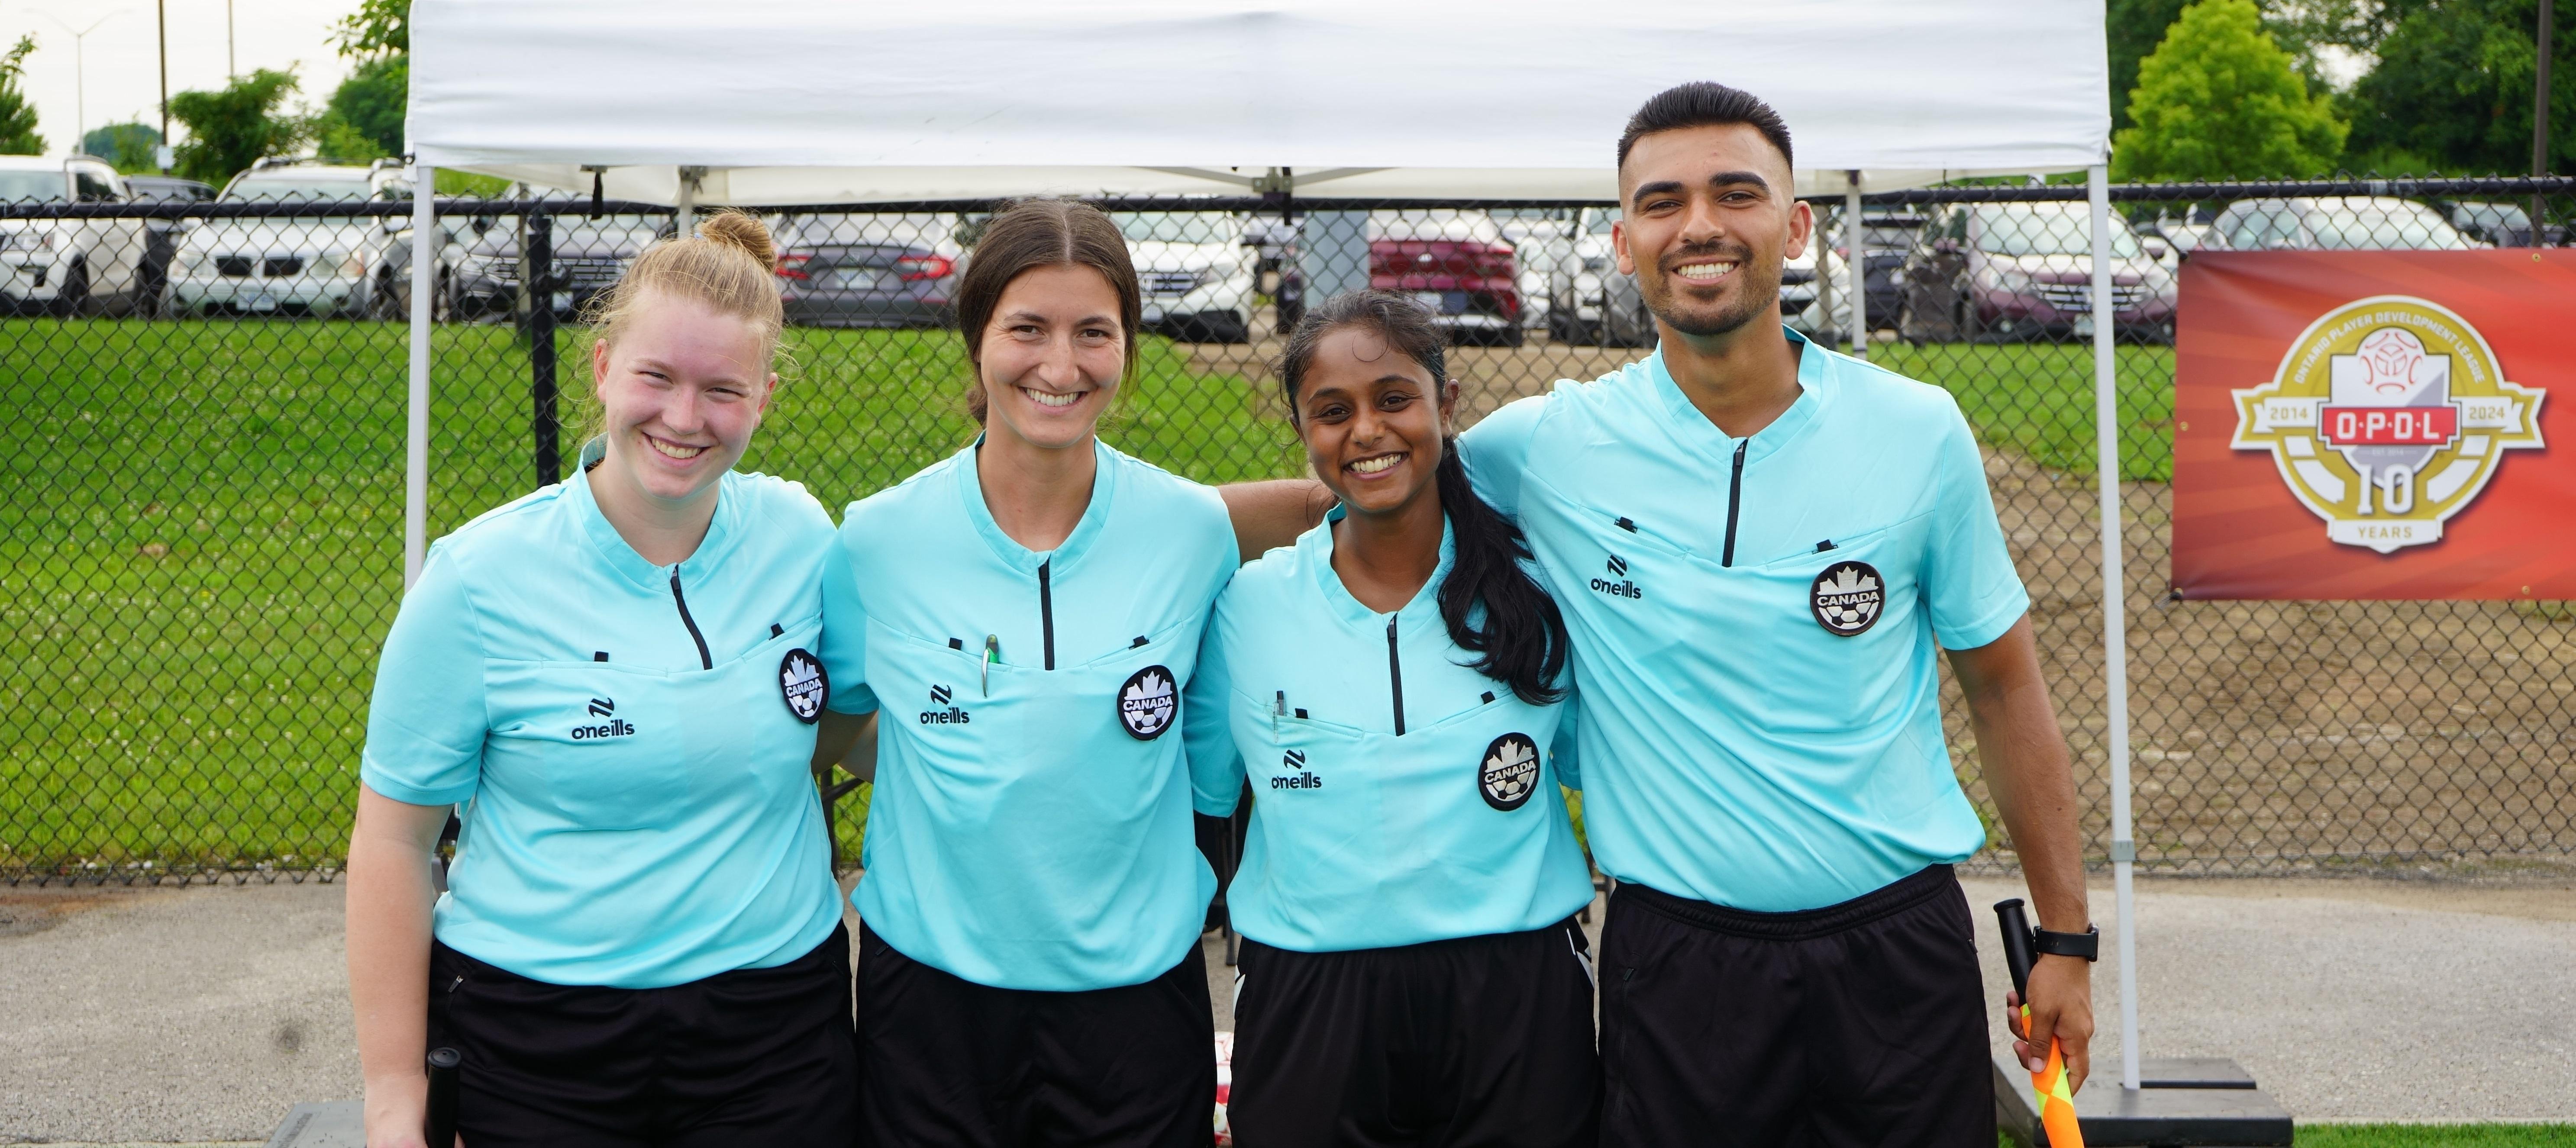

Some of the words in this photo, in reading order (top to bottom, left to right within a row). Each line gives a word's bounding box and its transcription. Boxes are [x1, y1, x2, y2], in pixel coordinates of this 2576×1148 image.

[2294, 336, 2331, 384] ONTARIO
[2329, 314, 2373, 342] PLAYER
[2376, 311, 2458, 344] DEVELOPMENT
[2455, 340, 2486, 384] LEAGUE
[2270, 407, 2308, 420] 2014
[2469, 406, 2505, 419] 2024
[2357, 464, 2413, 515] 10
[2358, 526, 2412, 539] YEARS
[1817, 591, 1880, 606] CANADA
[786, 678, 823, 697] CANADA
[1123, 696, 1173, 711] CANADA
[1485, 760, 1536, 783] CANADA
